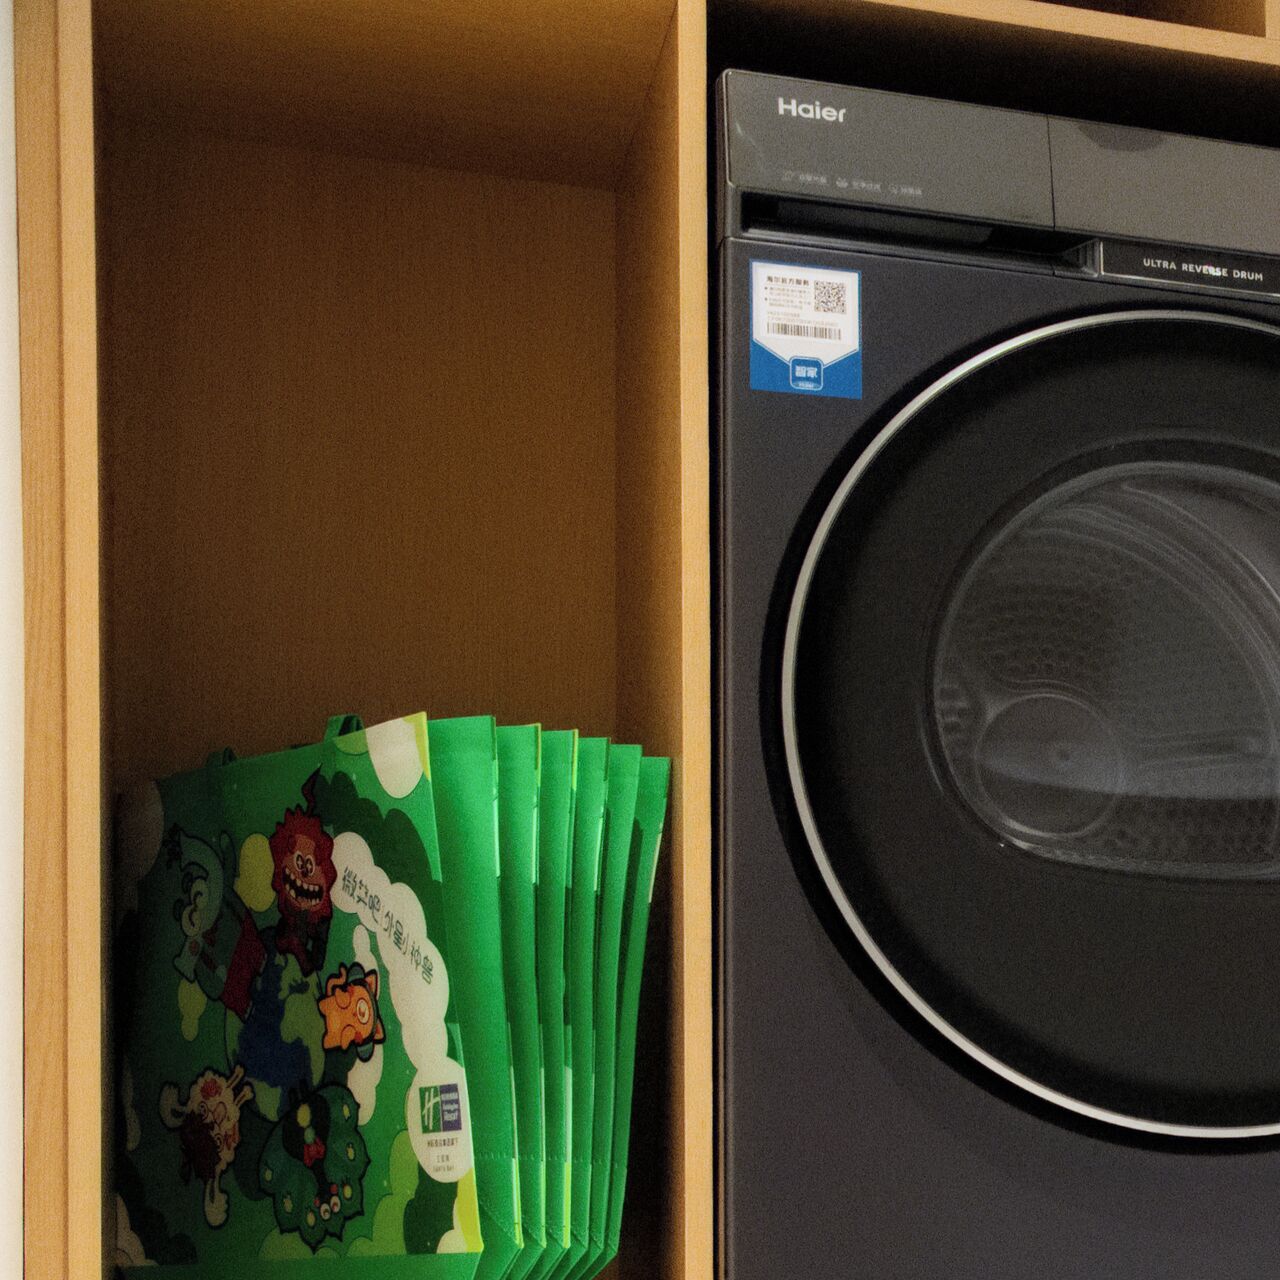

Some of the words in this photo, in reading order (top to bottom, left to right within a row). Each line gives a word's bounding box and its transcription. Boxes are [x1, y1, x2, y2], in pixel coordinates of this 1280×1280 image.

[778, 97, 846, 122] Haier
[1143, 258, 1177, 270] ULTRA
[1182, 263, 1228, 277] REVERSE
[1233, 269, 1263, 281] DRUM
